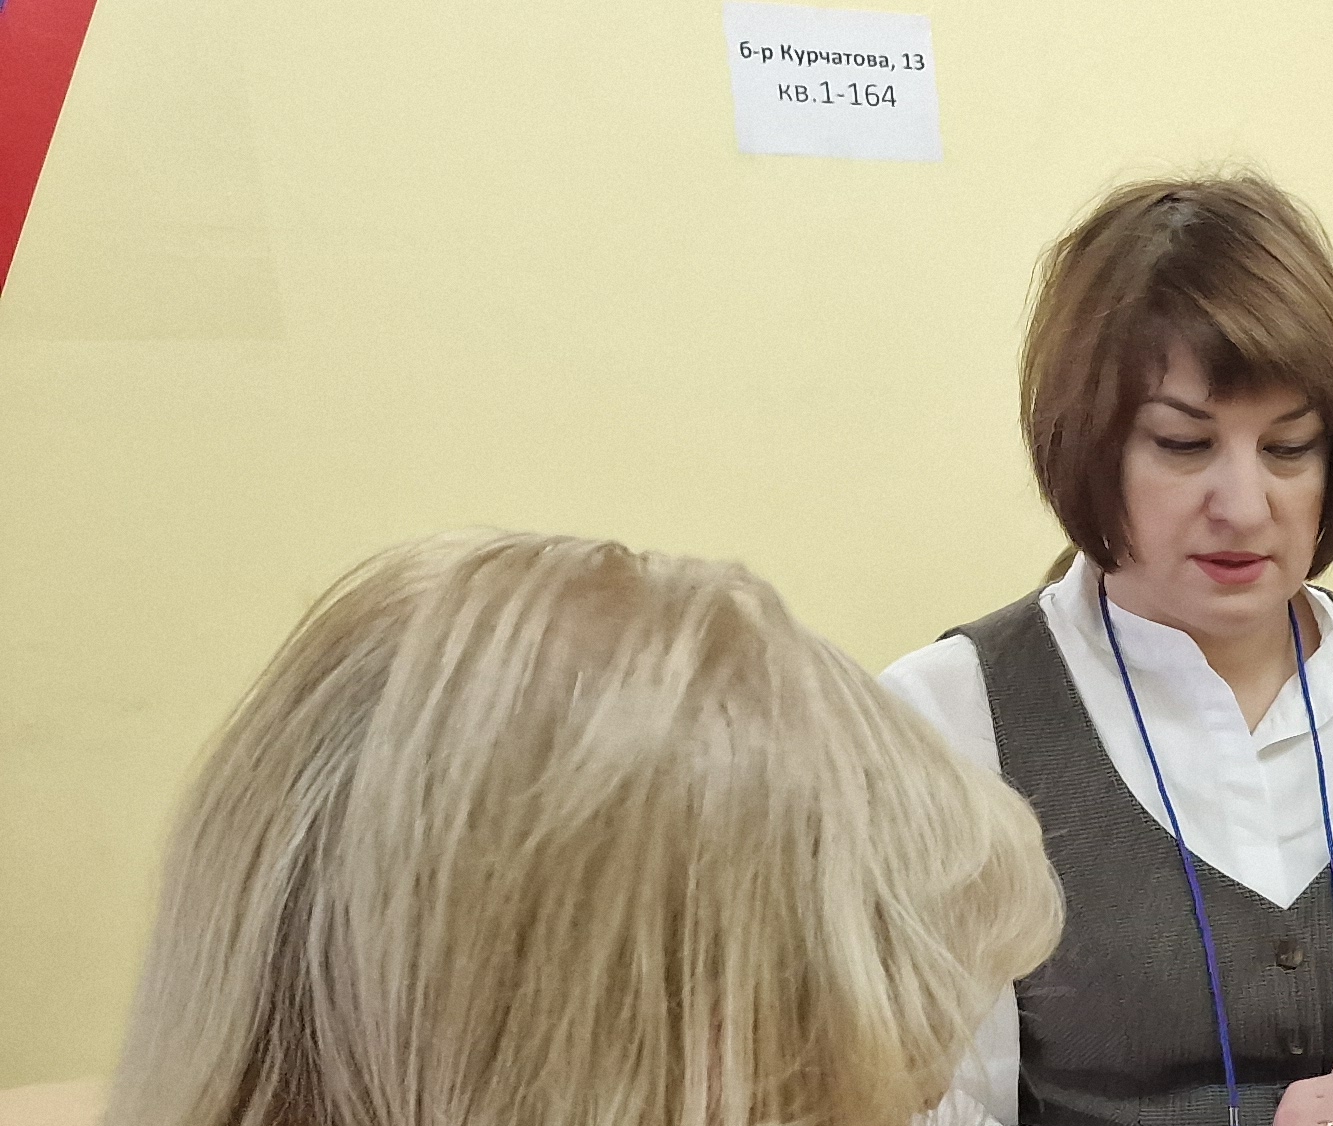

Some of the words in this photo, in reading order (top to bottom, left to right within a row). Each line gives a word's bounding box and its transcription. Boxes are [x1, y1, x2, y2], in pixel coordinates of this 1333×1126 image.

[739, 41, 774, 64] б-р
[780, 44, 897, 72] Курчатова,
[902, 52, 926, 71] 13
[777, 80, 898, 107] кв.1-164
